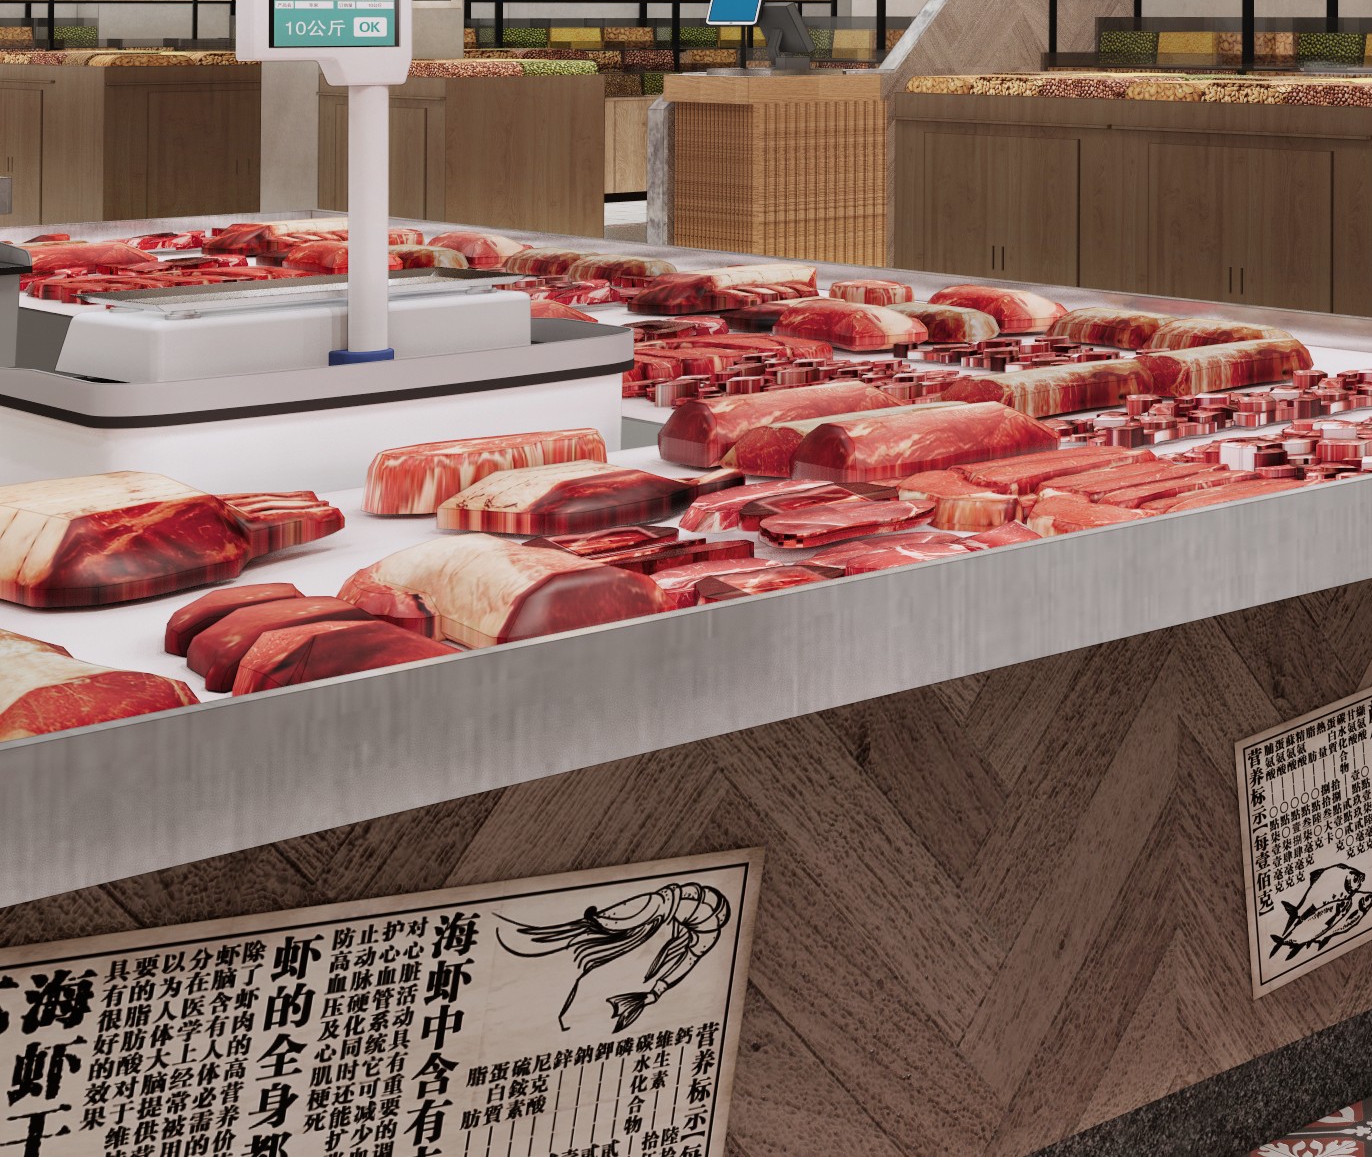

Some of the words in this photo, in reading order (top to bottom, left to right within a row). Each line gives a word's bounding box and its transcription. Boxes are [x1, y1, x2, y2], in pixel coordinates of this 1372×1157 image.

[285, 20, 345, 36] 10公斤
[359, 22, 380, 32] OK
[79, 959, 130, 1132] 具有很好的效果
[303, 927, 357, 1134] 防高血压及心肌梗死
[324, 924, 381, 1157] 止动脉硬化同时还能扩
[403, 912, 481, 1157] 海虾中含有
